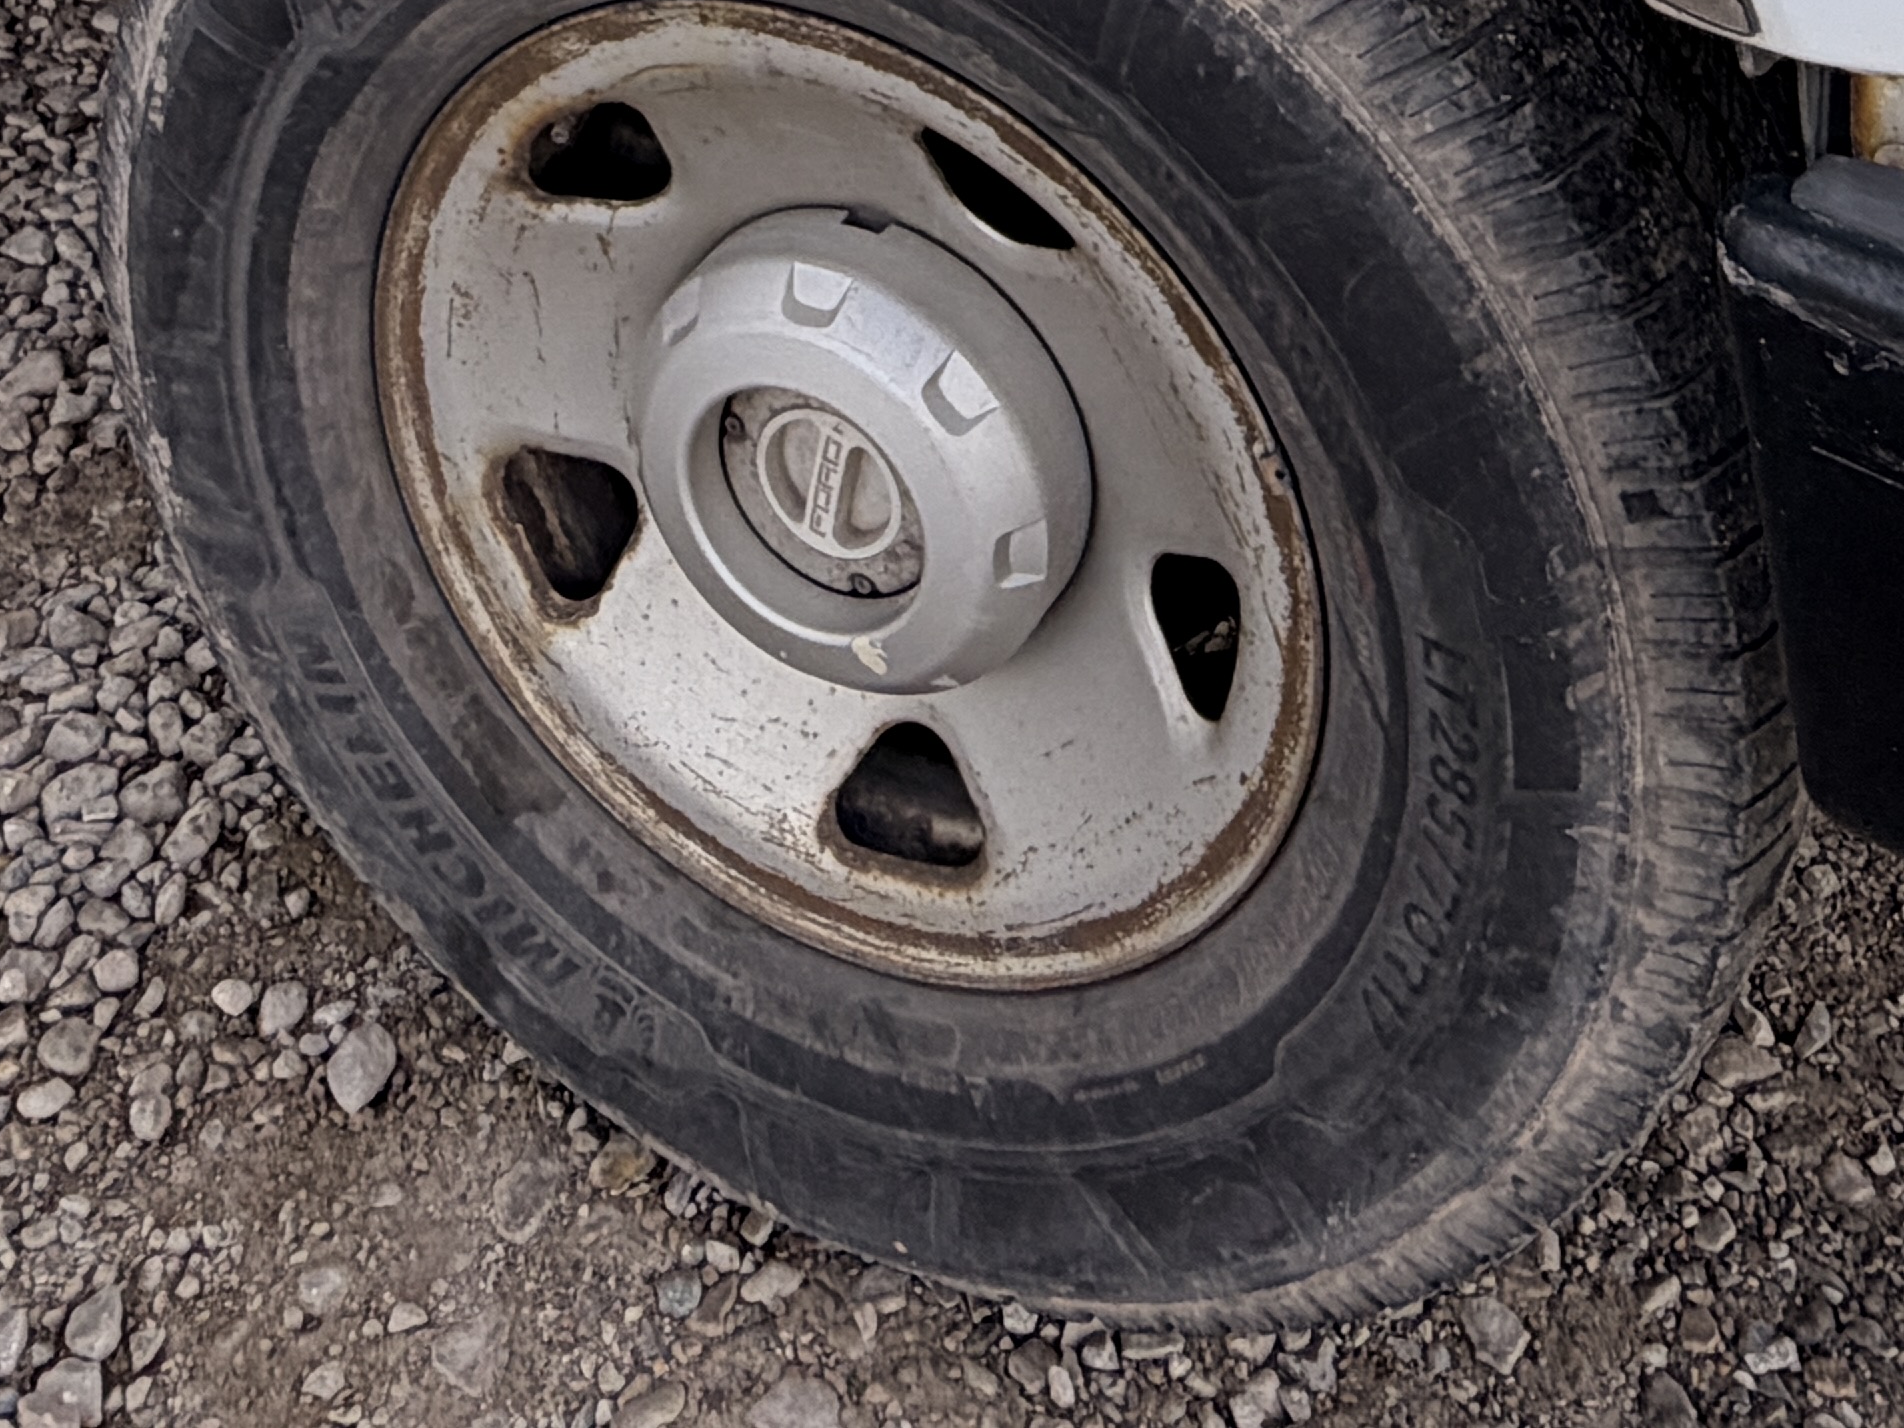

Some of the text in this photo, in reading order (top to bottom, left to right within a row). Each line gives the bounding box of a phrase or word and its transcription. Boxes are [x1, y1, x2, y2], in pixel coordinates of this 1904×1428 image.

[809, 435, 844, 538] FORD
[298, 641, 582, 987] MICHELIN
[1362, 632, 1479, 1049] LT285/70R17
